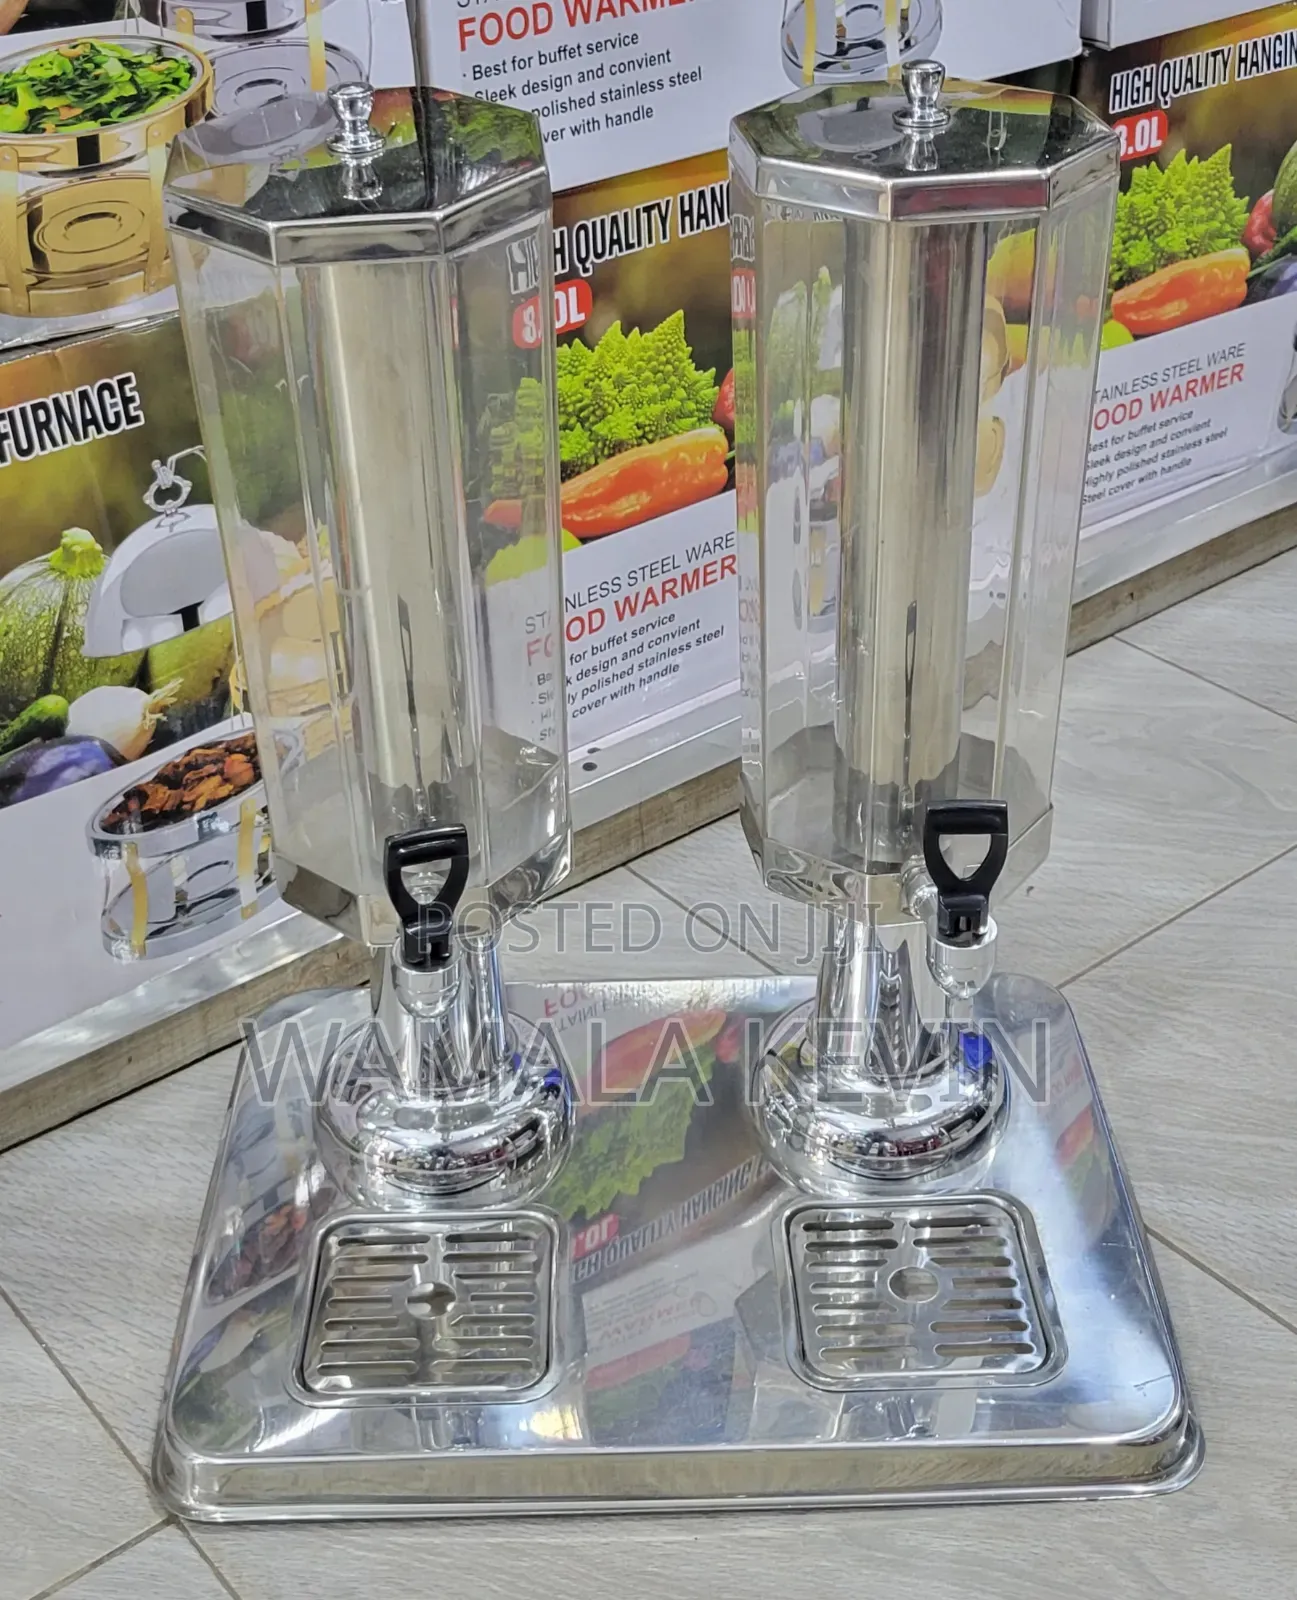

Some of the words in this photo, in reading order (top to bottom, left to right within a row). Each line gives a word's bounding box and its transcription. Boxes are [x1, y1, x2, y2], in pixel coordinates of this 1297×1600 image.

[458, 2, 553, 52] FOOD
[563, 0, 694, 27] WAR
[472, 59, 507, 80] Best
[511, 56, 533, 71] for
[538, 42, 582, 65] buffet
[586, 33, 639, 54] service
[521, 75, 572, 92] design
[578, 63, 604, 83] and
[609, 48, 671, 75] convient
[1110, 65, 1156, 113] HIGH
[1158, 44, 1234, 109] QUALITY
[532, 91, 595, 118] polished
[600, 78, 664, 104] stainless
[669, 65, 702, 87] steel
[543, 127, 566, 143] ver
[569, 116, 601, 136] with
[605, 105, 654, 130] handle
[575, 198, 671, 275] QUALITY
[678, 182, 730, 237] HAN
[1094, 372, 1158, 403] TAINLESS
[1161, 357, 1202, 383] STEEL
[1207, 342, 1245, 367] WARE
[1094, 398, 1142, 430] OOD
[1150, 363, 1244, 412] WARMER
[0, 373, 143, 465] FURNACE
[1111, 435, 1125, 446] for
[1158, 411, 1193, 429] service
[1114, 444, 1147, 461] design
[1149, 433, 1168, 448] and
[1117, 453, 1158, 478] polished
[1161, 439, 1202, 460] stainless
[1205, 427, 1228, 443] steel
[1108, 480, 1135, 495] cover
[1138, 470, 1157, 483] with
[1160, 458, 1192, 476] handle
[627, 554, 681, 587] STEEL
[685, 531, 735, 563] WARE
[614, 554, 736, 622] WARMER
[569, 650, 588, 665] for
[591, 632, 627, 656] buffet
[631, 613, 675, 638] service
[576, 656, 617, 681] design
[621, 642, 644, 661] and
[647, 618, 700, 649] convient
[581, 664, 634, 700] polished
[637, 641, 692, 671] stainless
[695, 624, 724, 646] steel
[572, 696, 607, 718] cover
[610, 682, 635, 701] with
[639, 663, 680, 688] handle
